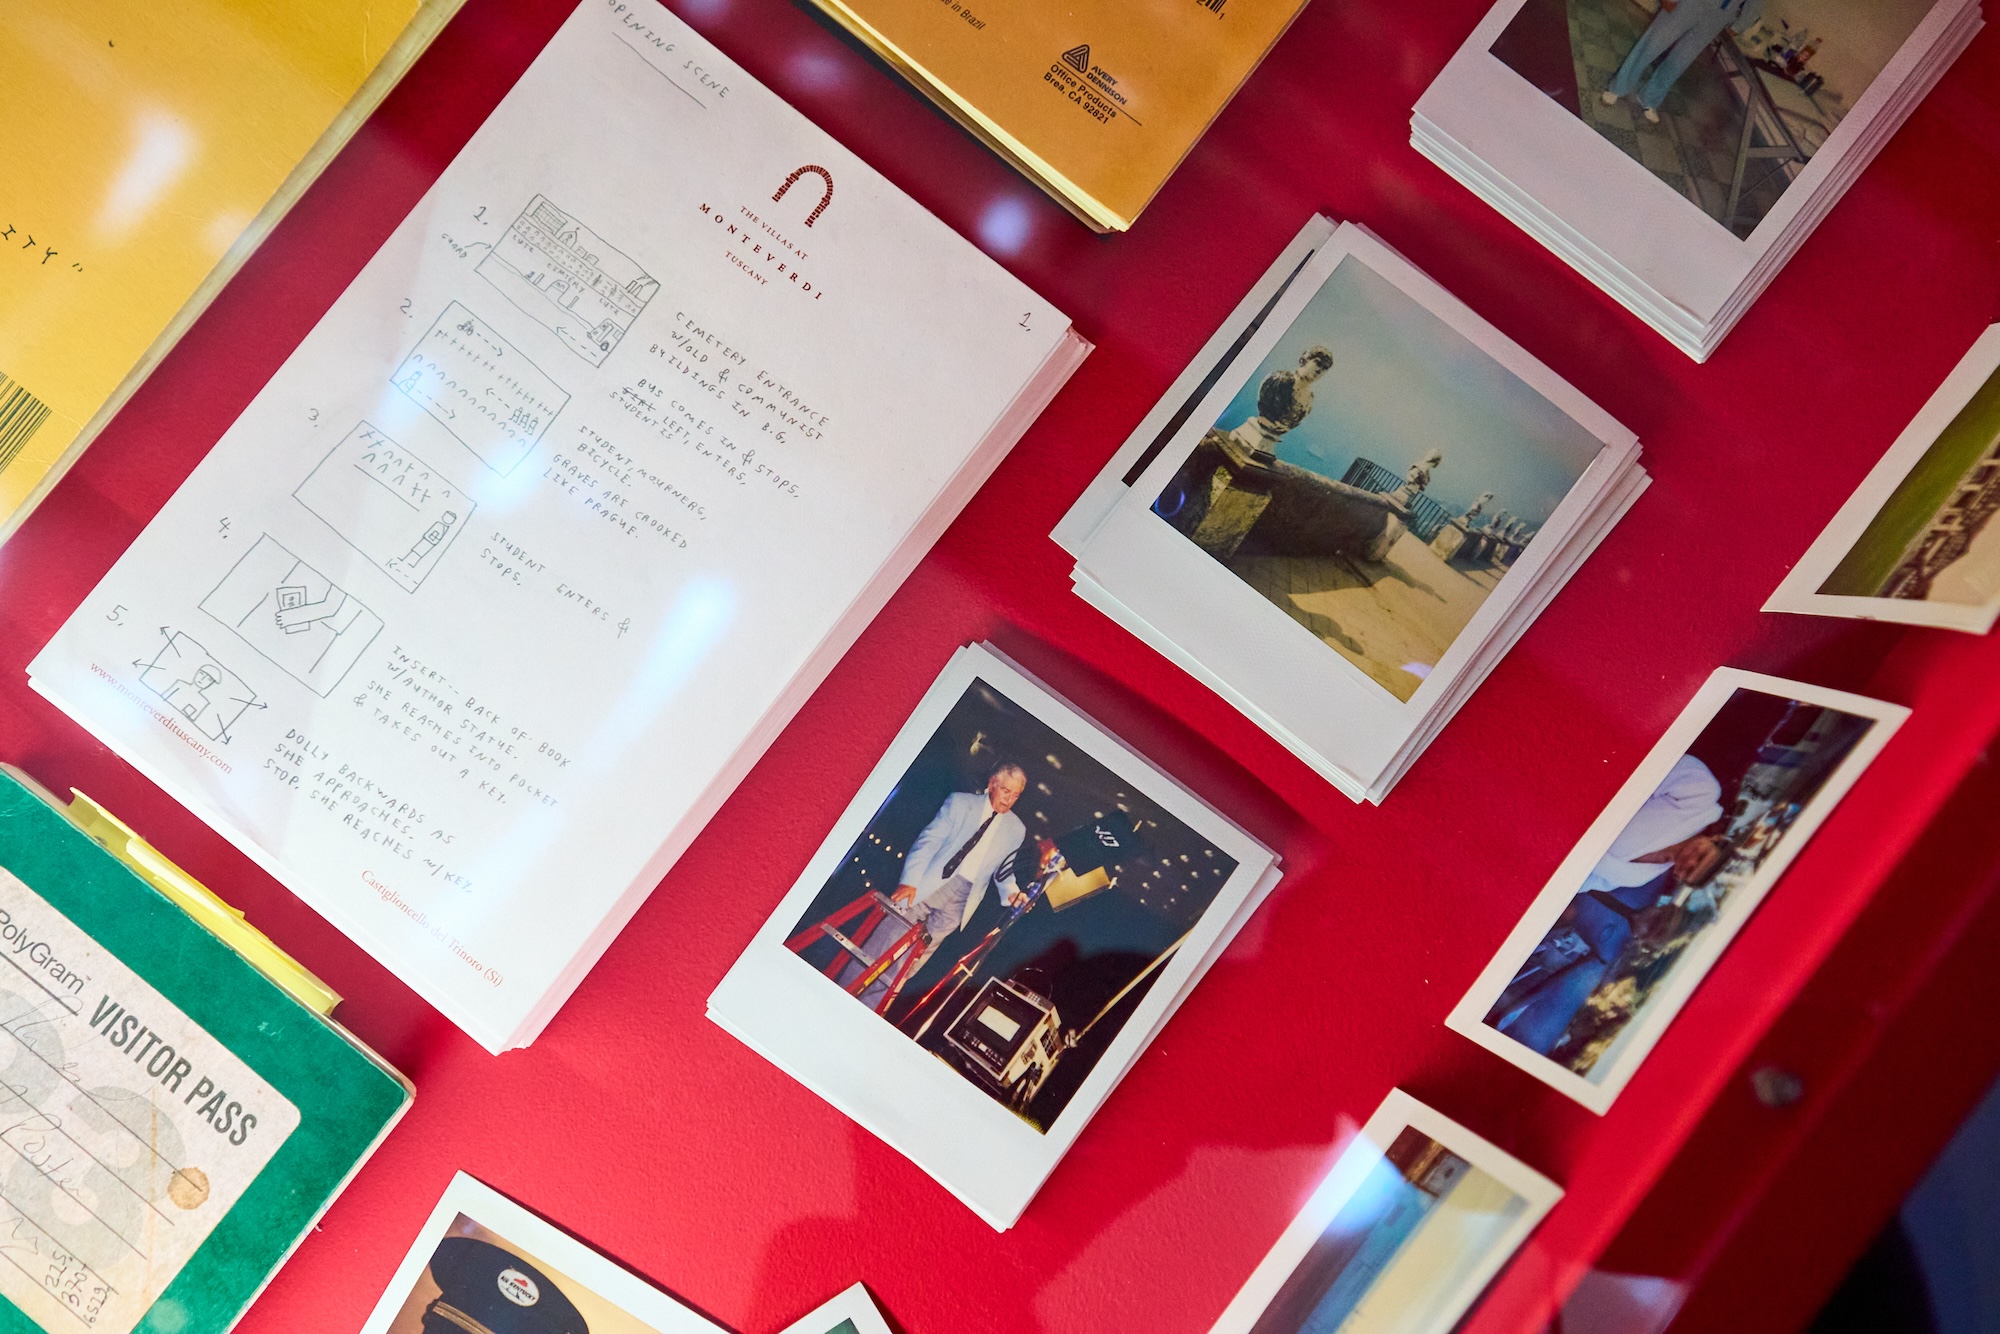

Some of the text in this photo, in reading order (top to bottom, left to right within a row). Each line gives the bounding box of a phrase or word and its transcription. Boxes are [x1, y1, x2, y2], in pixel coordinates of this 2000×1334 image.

[608, 0, 730, 98] OPENING SCENE
[951, 1, 986, 30] in Brazil
[1043, 72, 1109, 125] Brea, CA 92821
[1050, 64, 1117, 118] Office Products
[1086, 72, 1128, 105] DENNISON
[1091, 65, 1118, 86] AVERY
[699, 203, 823, 300] MONTEVERDI
[724, 250, 768, 286] TUSCANY
[739, 205, 809, 261] THE VILLAS AT
[649, 343, 726, 399] BUILDINGS
[731, 400, 751, 418] IN
[676, 311, 830, 427] CEMETERY ENTRANCE
[718, 368, 730, 383] &
[737, 383, 824, 441] COMMUNIST
[578, 425, 634, 472] STUDENT,
[609, 391, 673, 440] STUDENT IS
[637, 378, 664, 398] BUS
[670, 400, 714, 435] COMES
[720, 435, 737, 451] IN
[741, 449, 755, 466] &
[553, 453, 687, 549] GRAVES ARE CROOKED
[577, 442, 632, 487] BICYCLE.
[543, 467, 639, 539] LIKE PRAGUE.
[490, 532, 631, 639] STUDENT ENTERS &
[90, 661, 233, 775] www.monteverdituscany.com
[353, 693, 367, 708] &
[373, 708, 422, 742] TAKES
[430, 745, 457, 763] OUT
[459, 768, 469, 778] A
[367, 680, 558, 807] SHE REACHES INTO POCKET
[459, 718, 518, 760] STATUE.
[465, 696, 501, 725] BACK
[537, 741, 572, 768] BOOK
[274, 743, 414, 840] SHE APPROACHES.
[285, 728, 455, 844] DOLLY BACKWARDS AS
[309, 789, 339, 812] SHE
[343, 812, 414, 860] REACHES
[361, 870, 504, 988] Castiglioncello del Trinoro (Si)
[88, 994, 192, 1094] VISITOR
[183, 1075, 257, 1146] PASS
